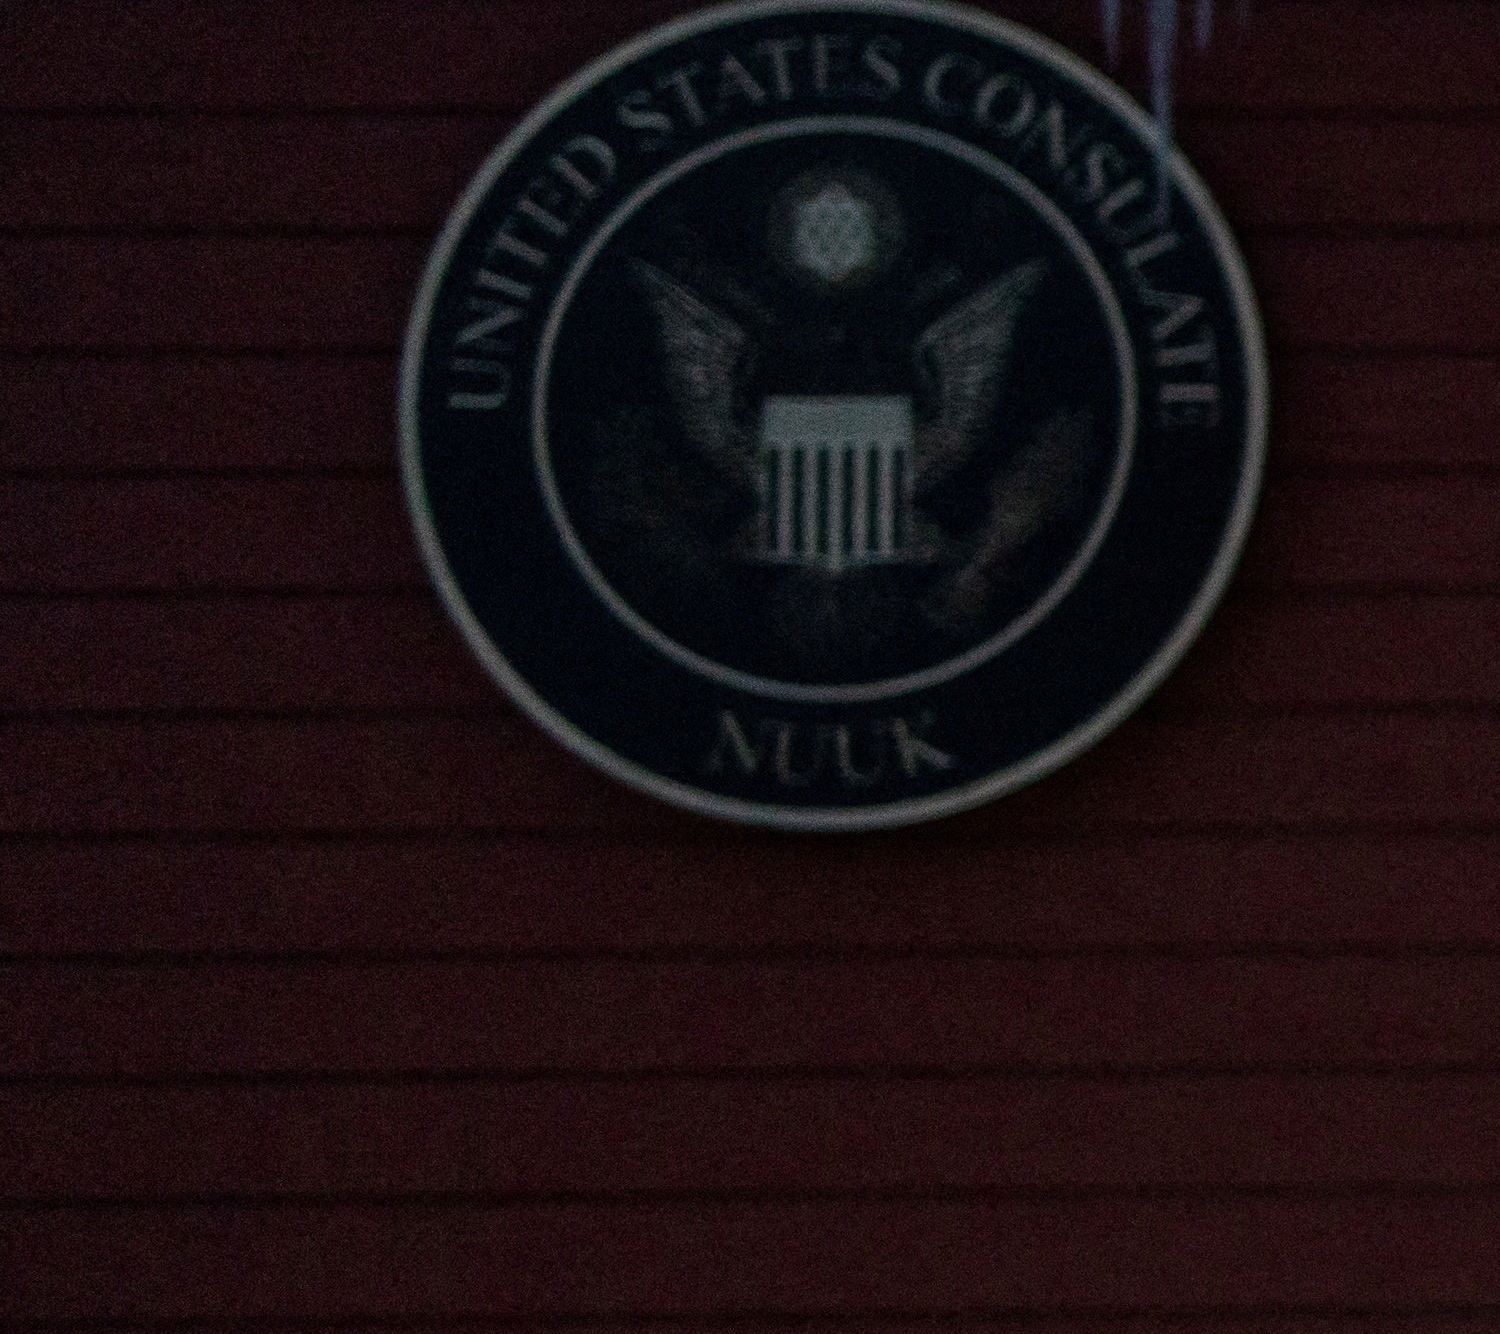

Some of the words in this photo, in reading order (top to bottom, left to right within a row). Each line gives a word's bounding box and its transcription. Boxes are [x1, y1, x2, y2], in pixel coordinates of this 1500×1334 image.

[449, 133, 617, 410] UNITED
[616, 34, 901, 153] STATES
[922, 52, 1221, 428] CONSULATE
[711, 711, 954, 788] NUUK
